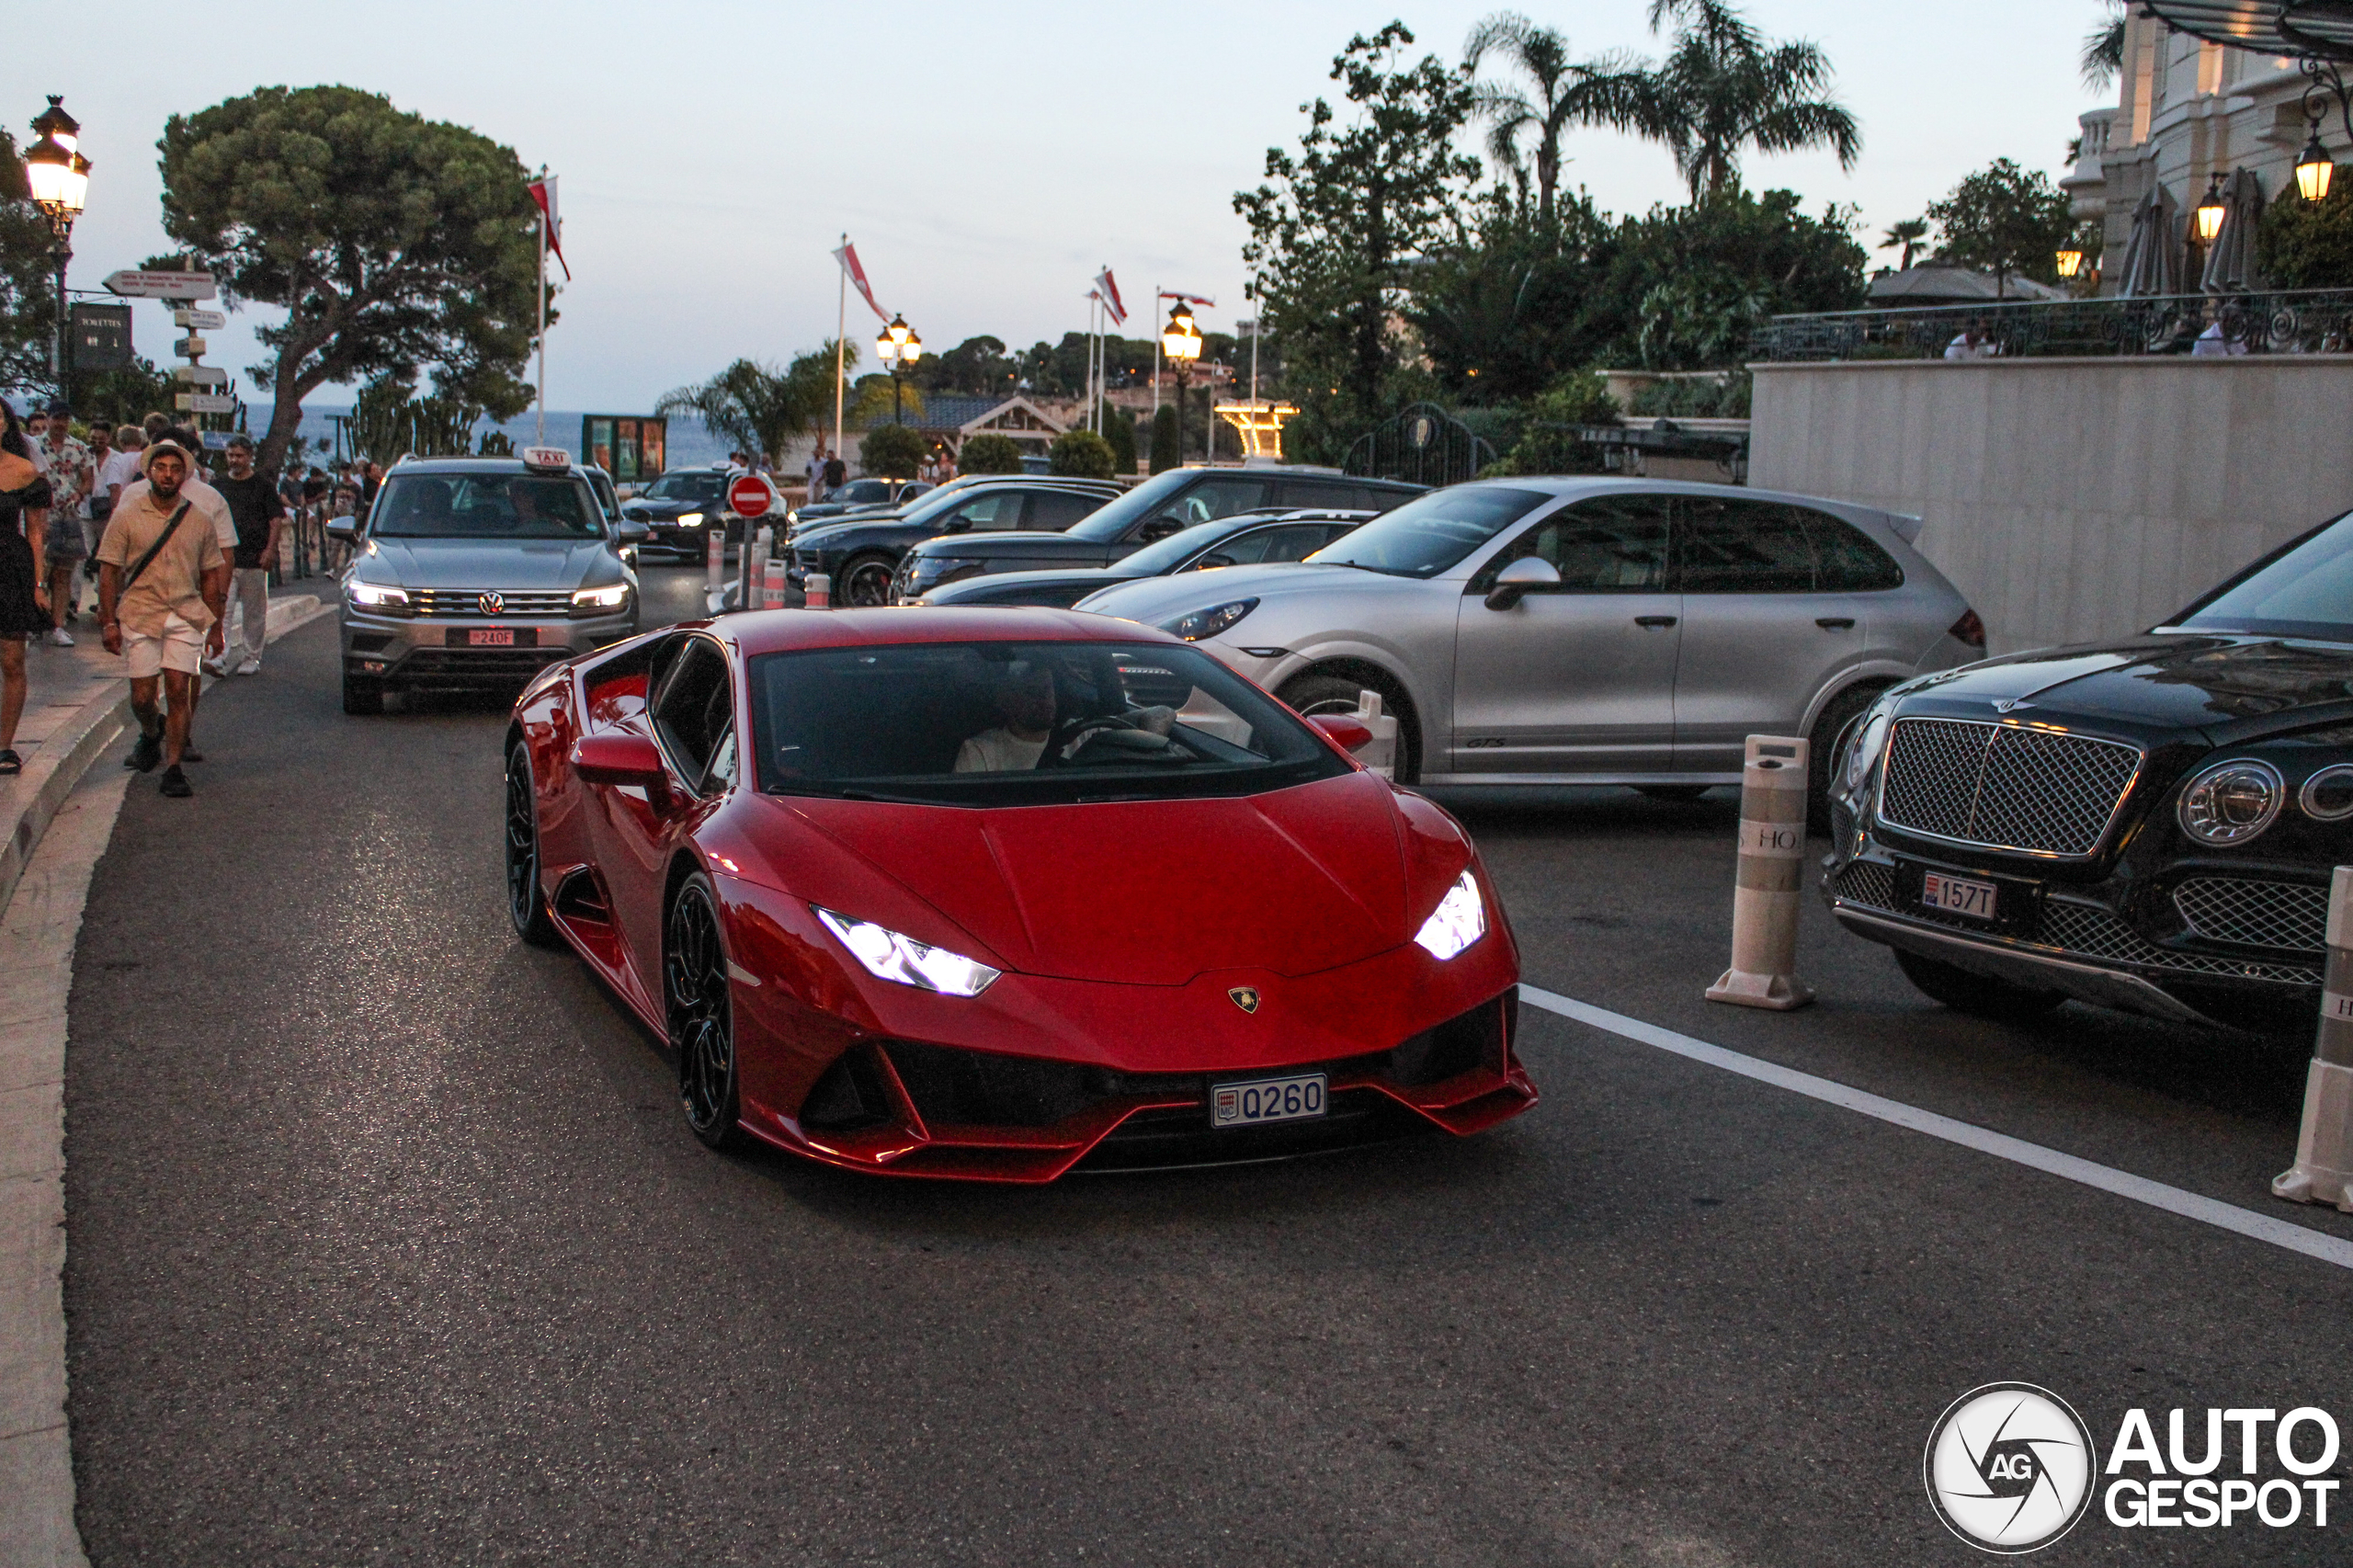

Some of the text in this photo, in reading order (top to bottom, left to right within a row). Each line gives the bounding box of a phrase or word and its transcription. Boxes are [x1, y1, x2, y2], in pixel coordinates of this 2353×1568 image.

[537, 450, 564, 464] TAXI
[481, 632, 511, 644] 240F
[1467, 738, 1506, 748] GTS
[1943, 881, 1992, 914] 157T
[1244, 1081, 1321, 1119] Q260
[1221, 1106, 1234, 1116] MC
